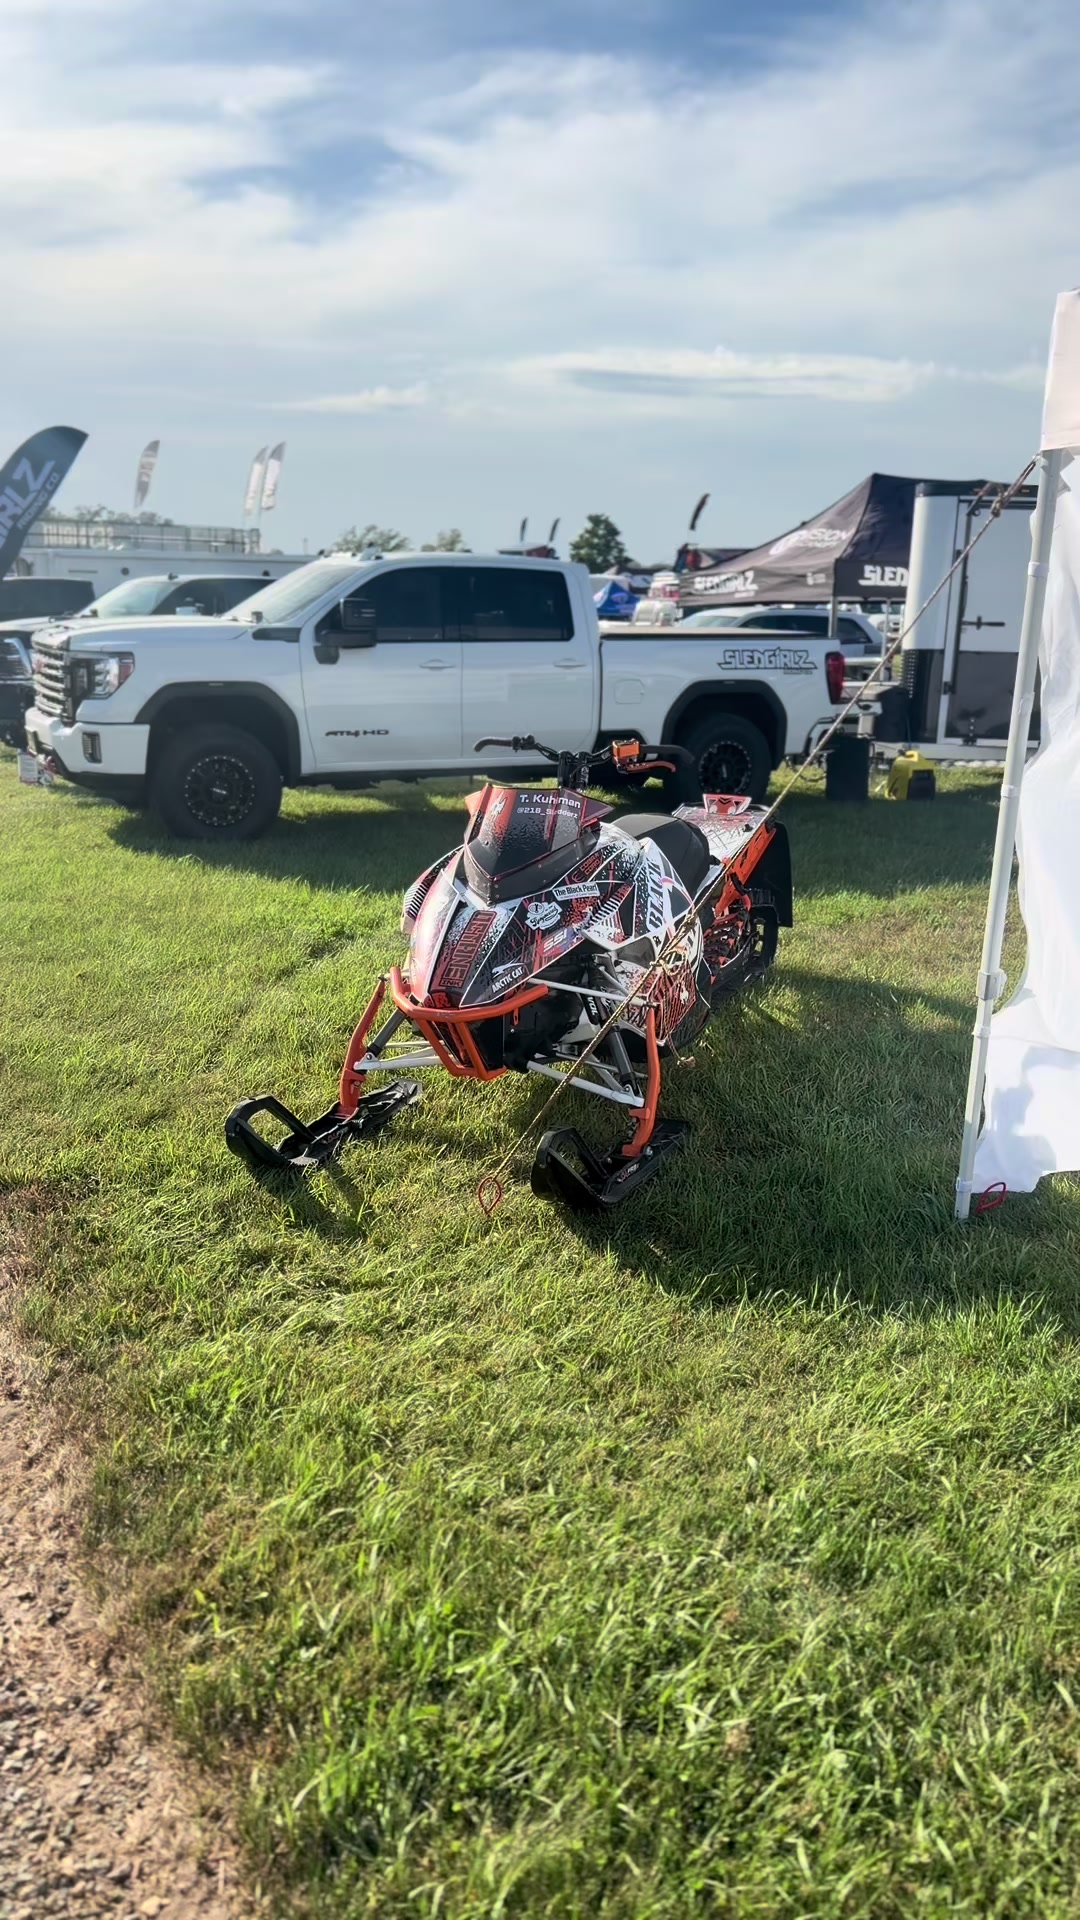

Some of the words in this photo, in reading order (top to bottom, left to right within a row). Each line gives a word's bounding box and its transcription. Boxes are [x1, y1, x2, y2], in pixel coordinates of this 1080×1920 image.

[520, 794, 529, 802] T.
[554, 887, 567, 897] The
[567, 884, 583, 894] Black
[583, 883, 598, 892] Pearl
[491, 975, 513, 993] ARCTIC
[511, 966, 524, 981] CAT
